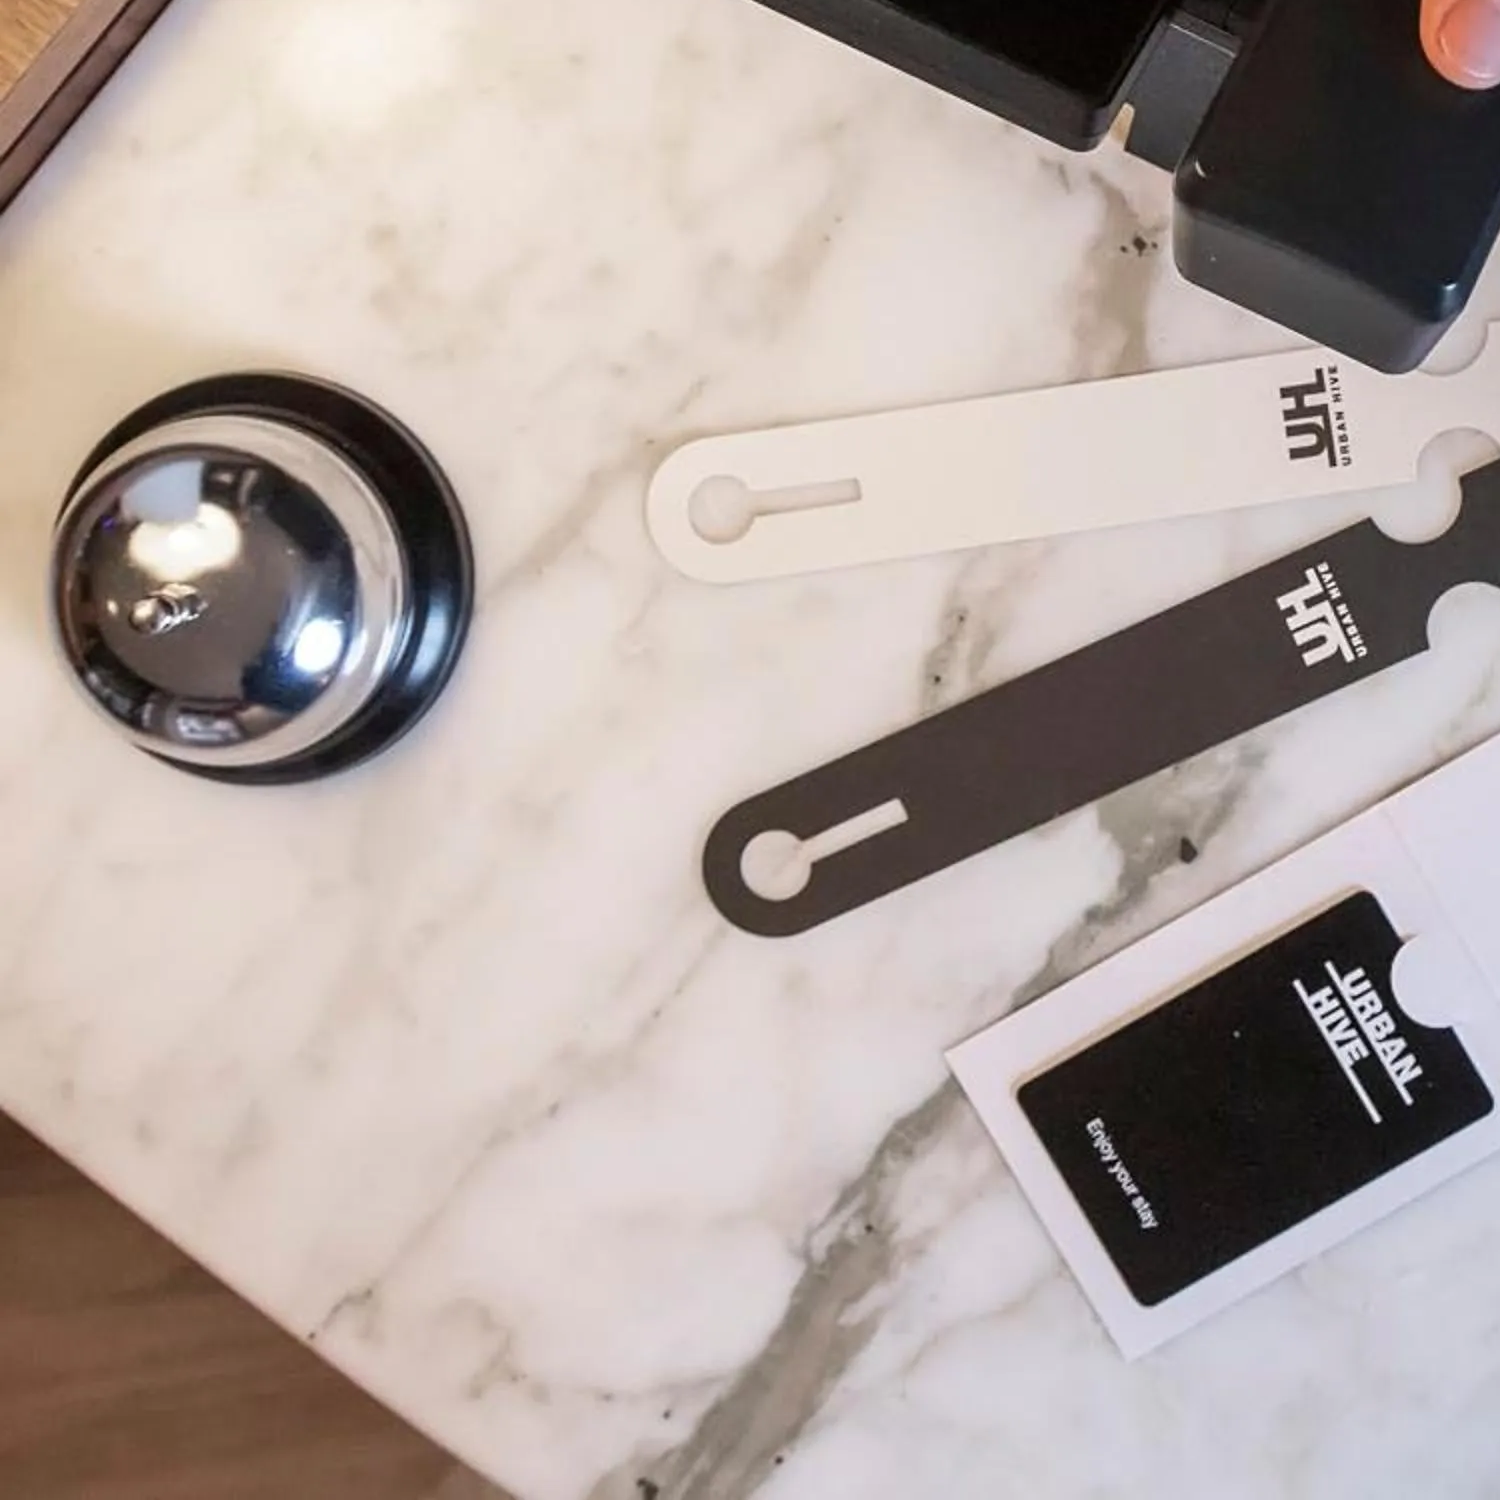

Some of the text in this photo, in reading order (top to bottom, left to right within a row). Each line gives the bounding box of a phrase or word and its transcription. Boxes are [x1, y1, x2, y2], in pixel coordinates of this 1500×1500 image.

[1327, 364, 1352, 465] URBAN HIVE
[1316, 560, 1368, 659] URBAN HIVE
[1305, 983, 1369, 1068] HIVE
[1338, 965, 1423, 1087] URBAN
[1082, 1116, 1160, 1231] Enjoy your stay
